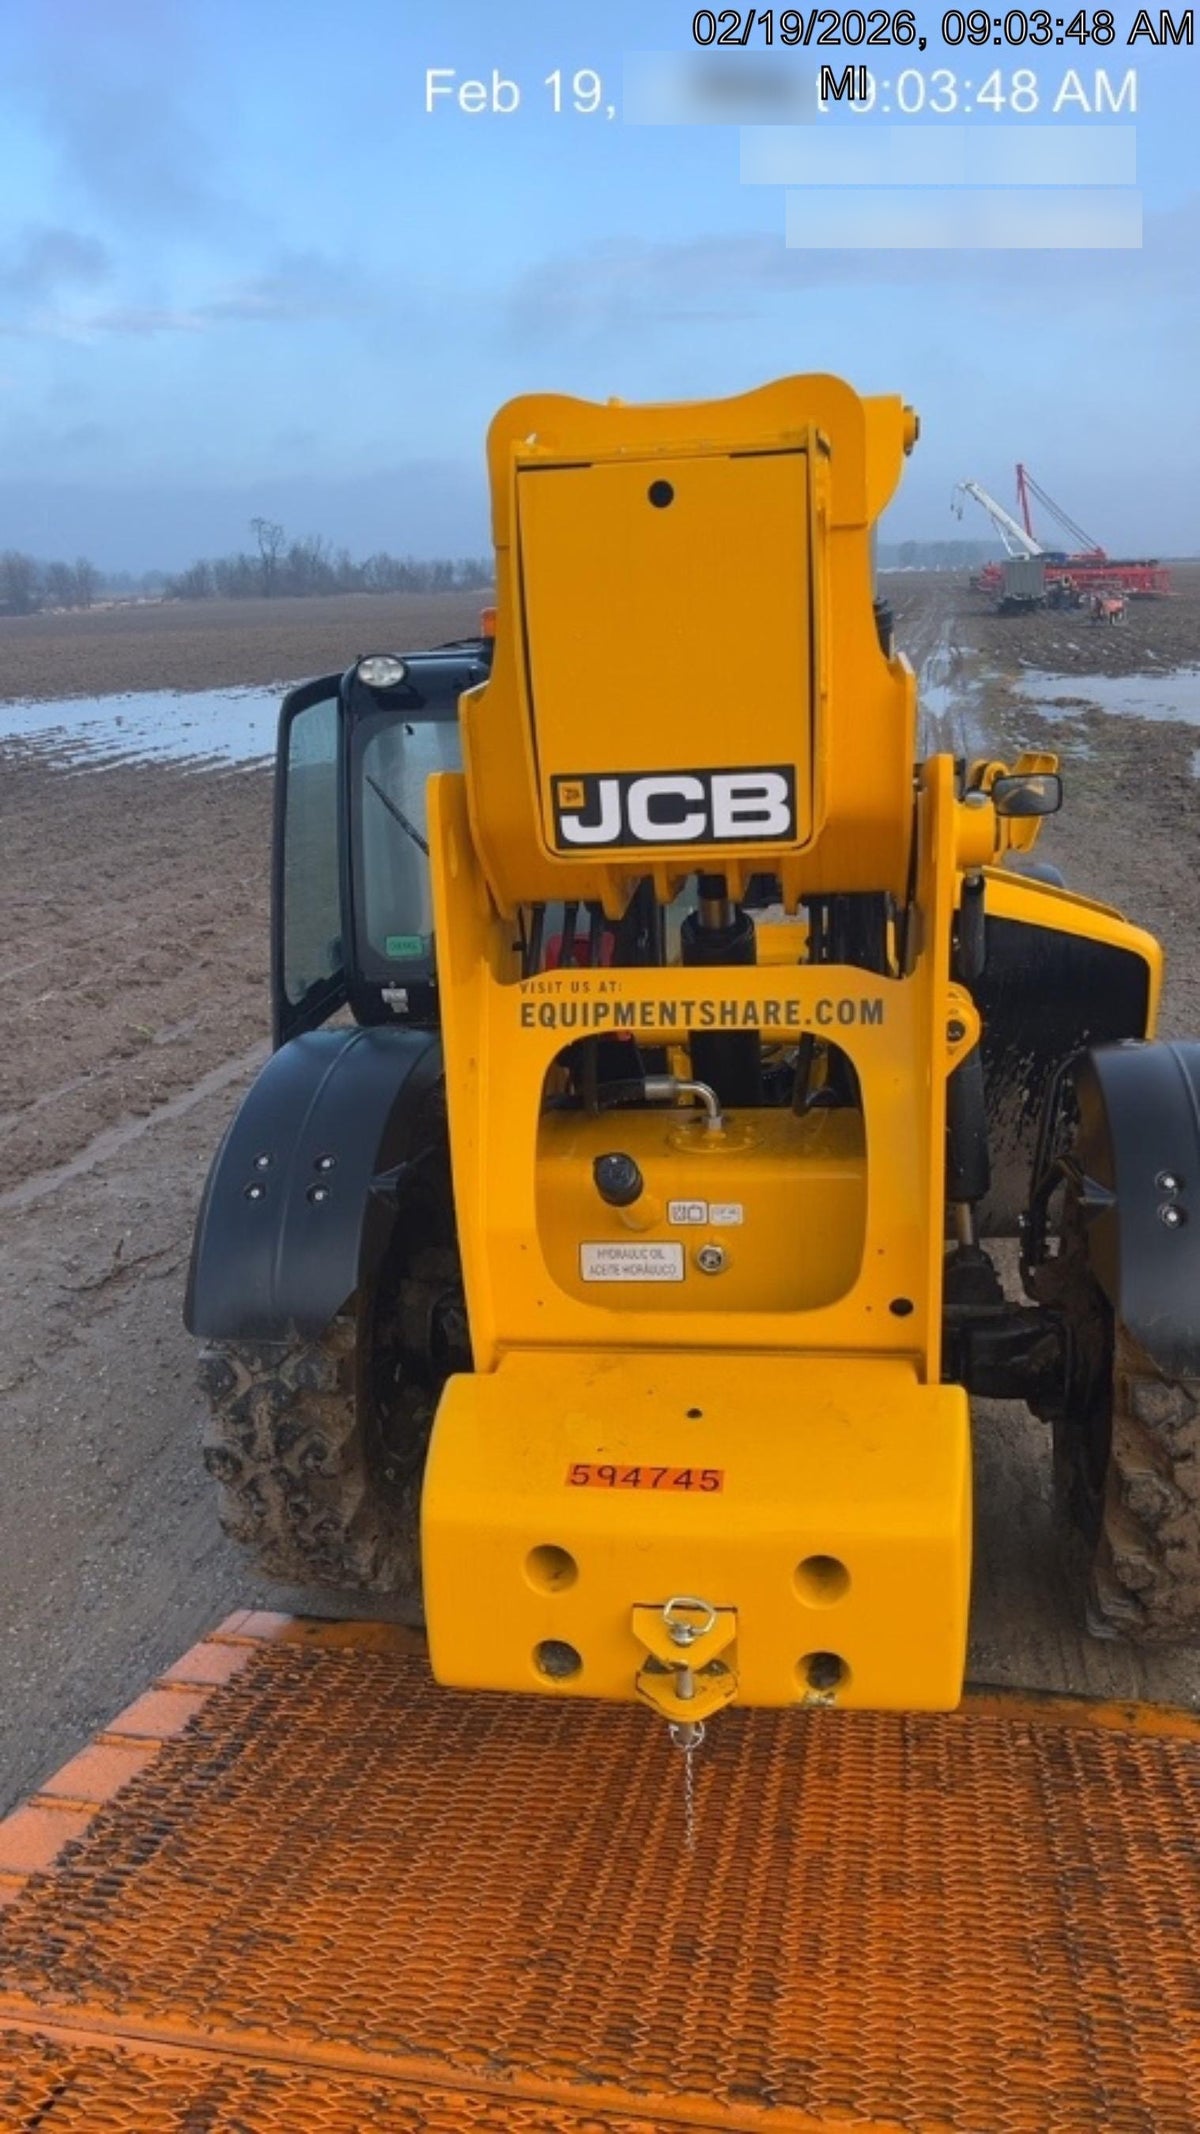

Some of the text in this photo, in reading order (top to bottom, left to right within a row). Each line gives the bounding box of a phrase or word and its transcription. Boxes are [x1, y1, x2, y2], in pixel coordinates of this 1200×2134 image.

[560, 773, 791, 843] JCB
[520, 981, 622, 994] VISIT US AT:
[521, 998, 884, 1029] EQUIPMENTSHARE.COM
[570, 1465, 720, 1492] 594745
